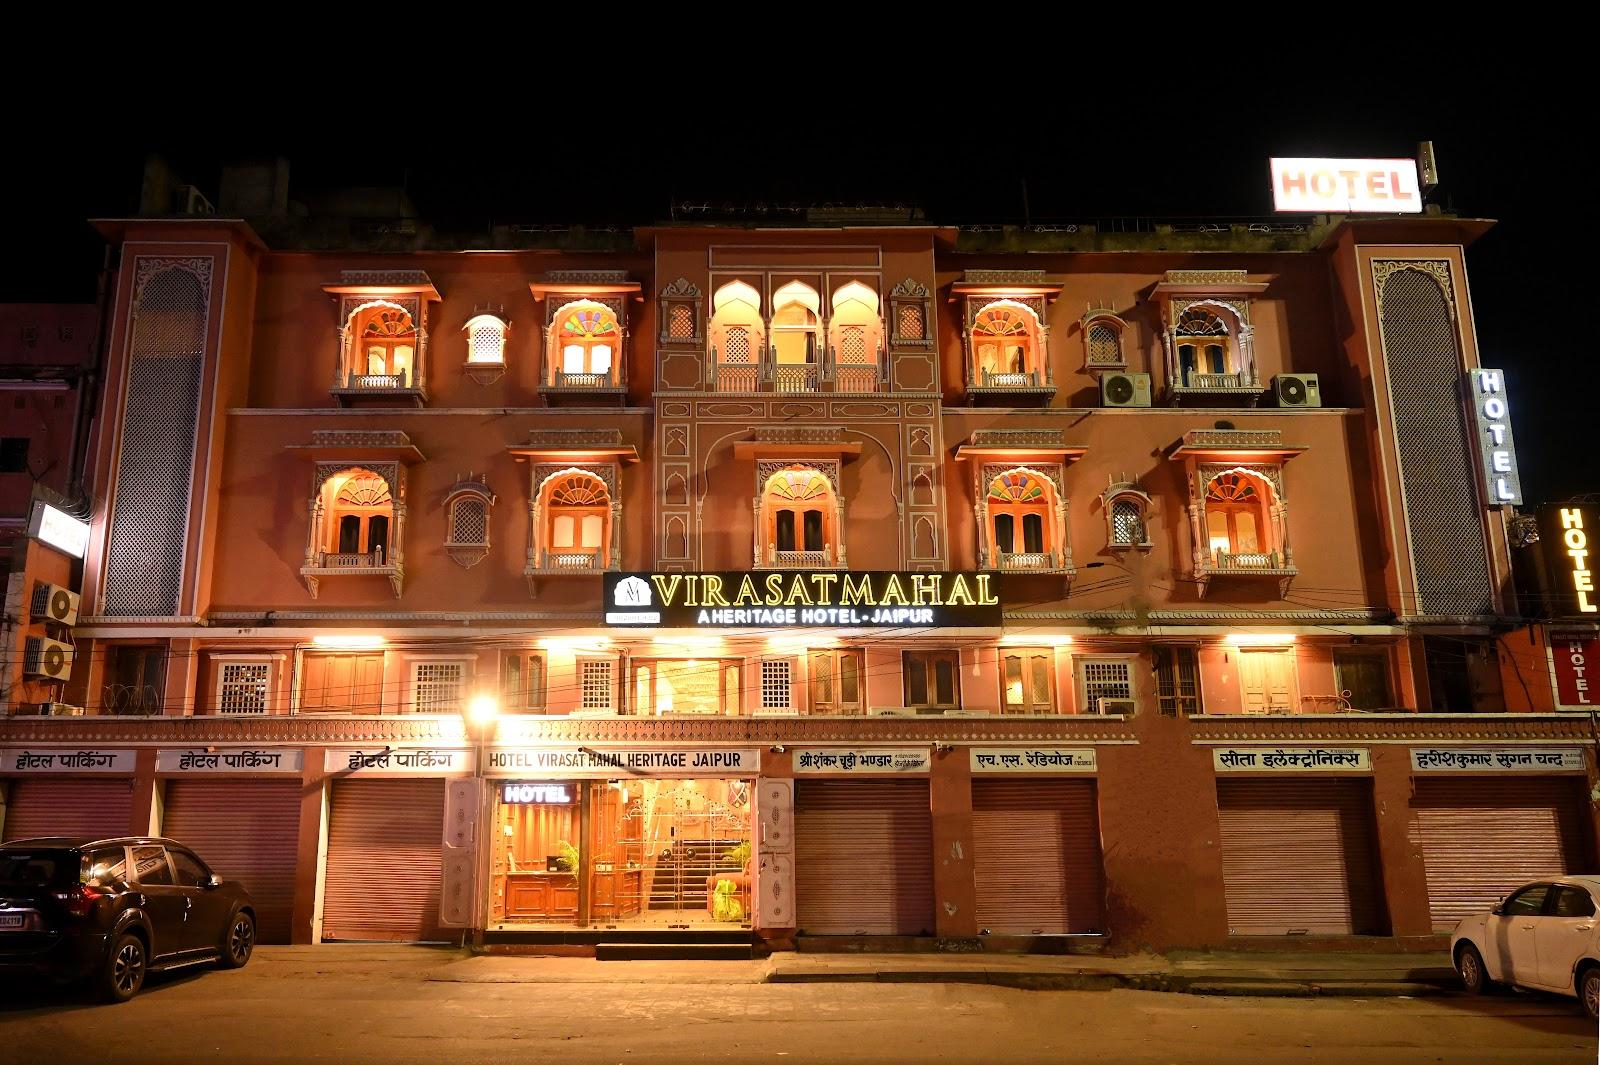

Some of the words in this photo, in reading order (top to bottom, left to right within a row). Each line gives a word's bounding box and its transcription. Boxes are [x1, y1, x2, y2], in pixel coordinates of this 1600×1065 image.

[1281, 169, 1413, 200] HOTEL
[1480, 370, 1515, 502] HOTEL
[1560, 507, 1598, 614] HOTEL
[1569, 641, 1590, 704] HOTEL
[16, 752, 56, 769] होटल
[58, 751, 117, 768] पार्किंग
[179, 751, 220, 769] होटल
[222, 751, 281, 768] पार्किंग
[349, 751, 391, 769] होटल
[394, 751, 452, 768] पार्किंग
[490, 752, 532, 767] HOTEL
[538, 753, 585, 767] VIRASAT
[588, 753, 624, 767] MAHAL
[627, 753, 686, 767] HERITAGE
[692, 752, 741, 767] JAIPUR
[859, 754, 893, 768] भण्डार
[1220, 750, 1256, 768] सीता
[1496, 752, 1532, 769] सुगन
[504, 785, 571, 803] HOTEL
